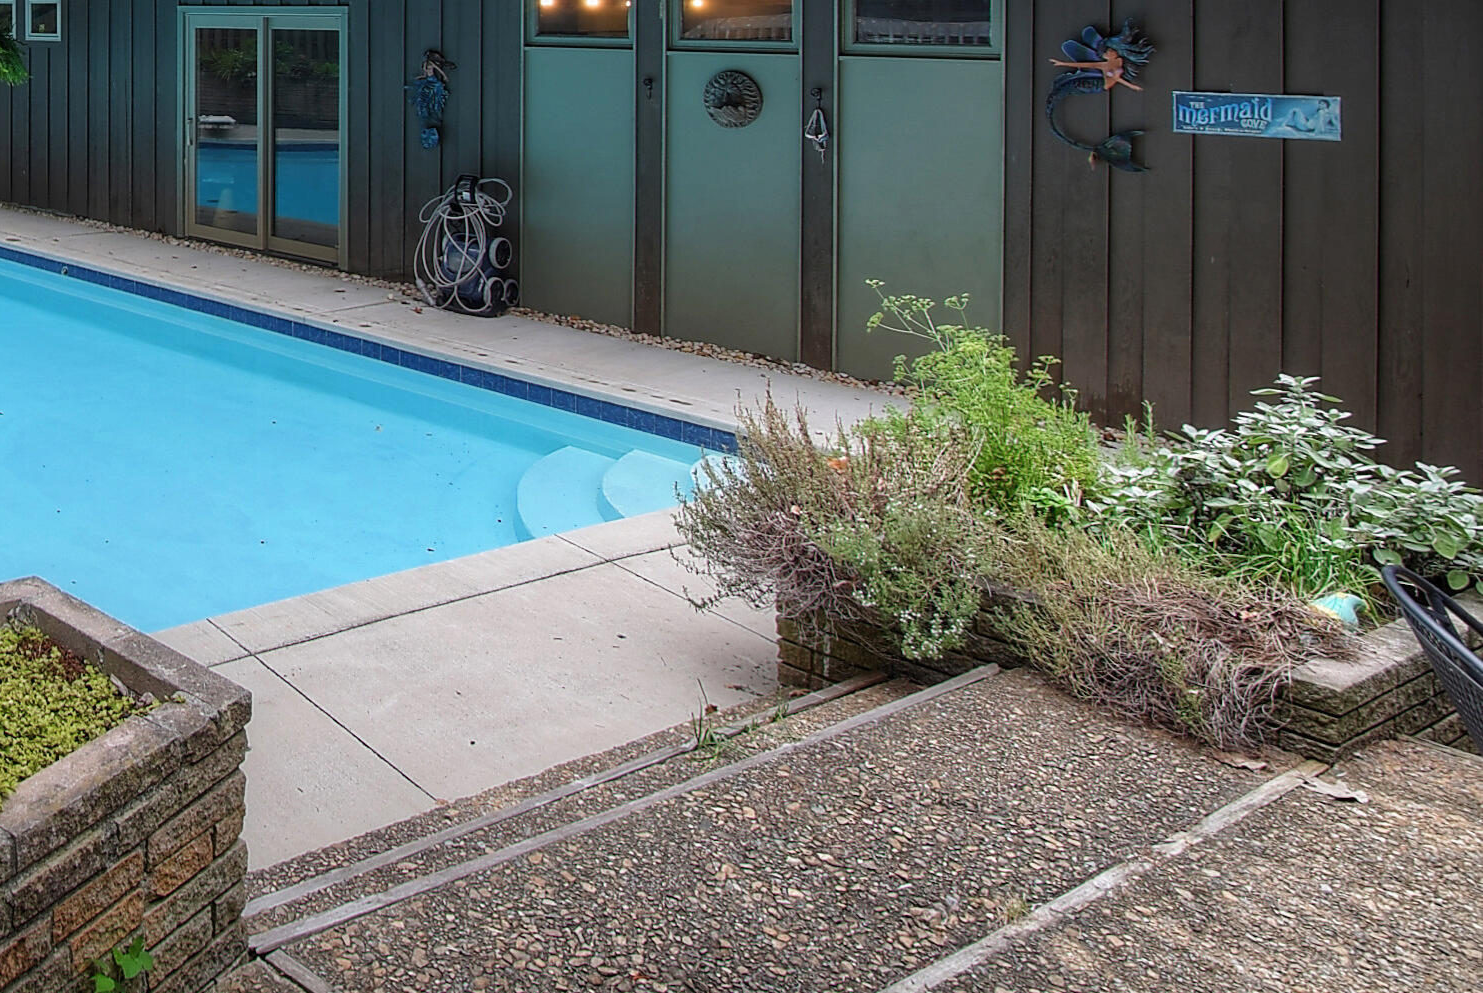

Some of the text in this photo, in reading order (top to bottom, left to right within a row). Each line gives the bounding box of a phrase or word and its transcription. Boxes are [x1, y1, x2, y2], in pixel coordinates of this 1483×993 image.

[1189, 101, 1205, 109] THE
[1178, 97, 1273, 127] mermaid
[1240, 118, 1268, 130] COVE
